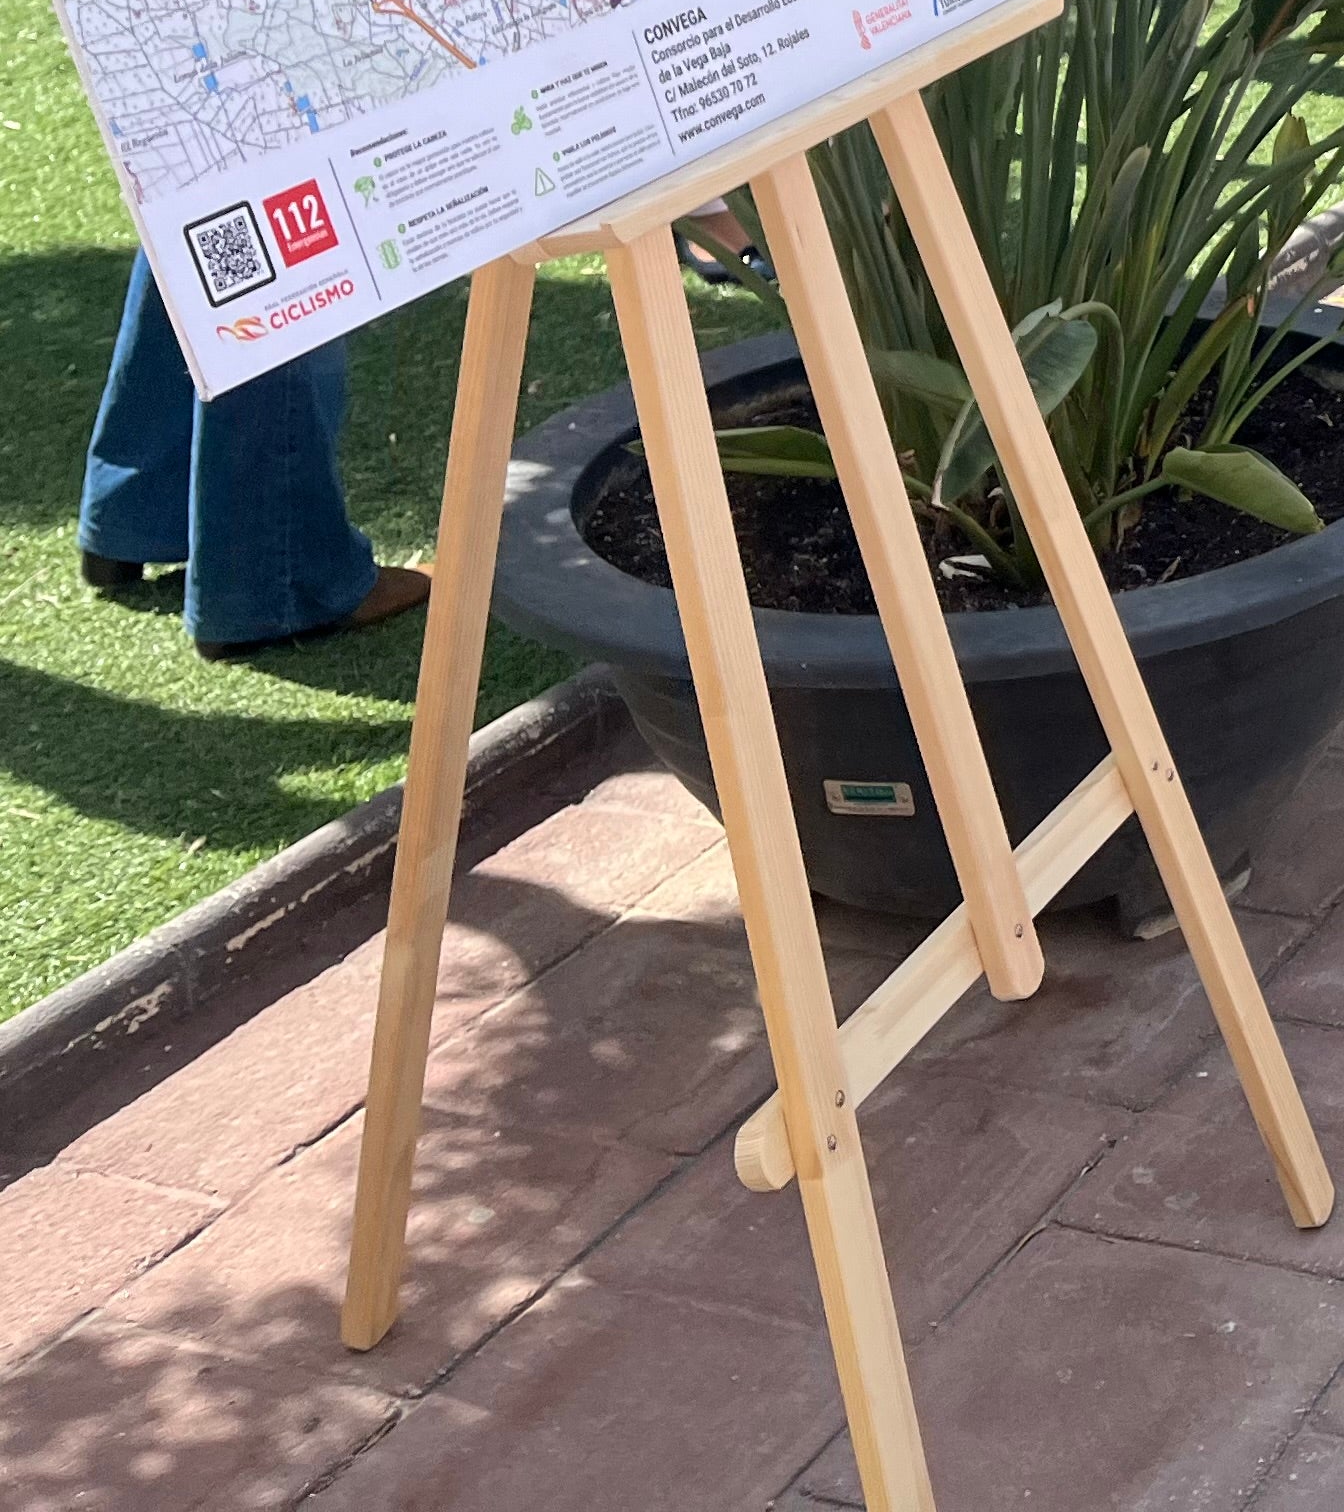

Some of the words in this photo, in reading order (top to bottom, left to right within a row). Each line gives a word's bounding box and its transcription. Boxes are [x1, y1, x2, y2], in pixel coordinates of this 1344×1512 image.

[644, 6, 708, 44] CONVEGA
[651, 34, 702, 65] Consorcio
[702, 24, 724, 46] para
[725, 16, 735, 32] el
[658, 69, 671, 84] de
[672, 63, 683, 79] la
[682, 52, 709, 73] Vega
[709, 41, 732, 61] Baja
[664, 89, 677, 104] C/
[678, 69, 721, 99] Malecón
[720, 58, 736, 77] del
[777, 27, 810, 51] Rojales
[671, 102, 699, 123] Tfno:
[698, 84, 730, 111] 96530
[731, 79, 744, 94] 70
[744, 72, 758, 87] 72
[678, 91, 766, 144] www.convega.com
[272, 194, 325, 241] 112
[270, 279, 355, 330] CICLISMO
